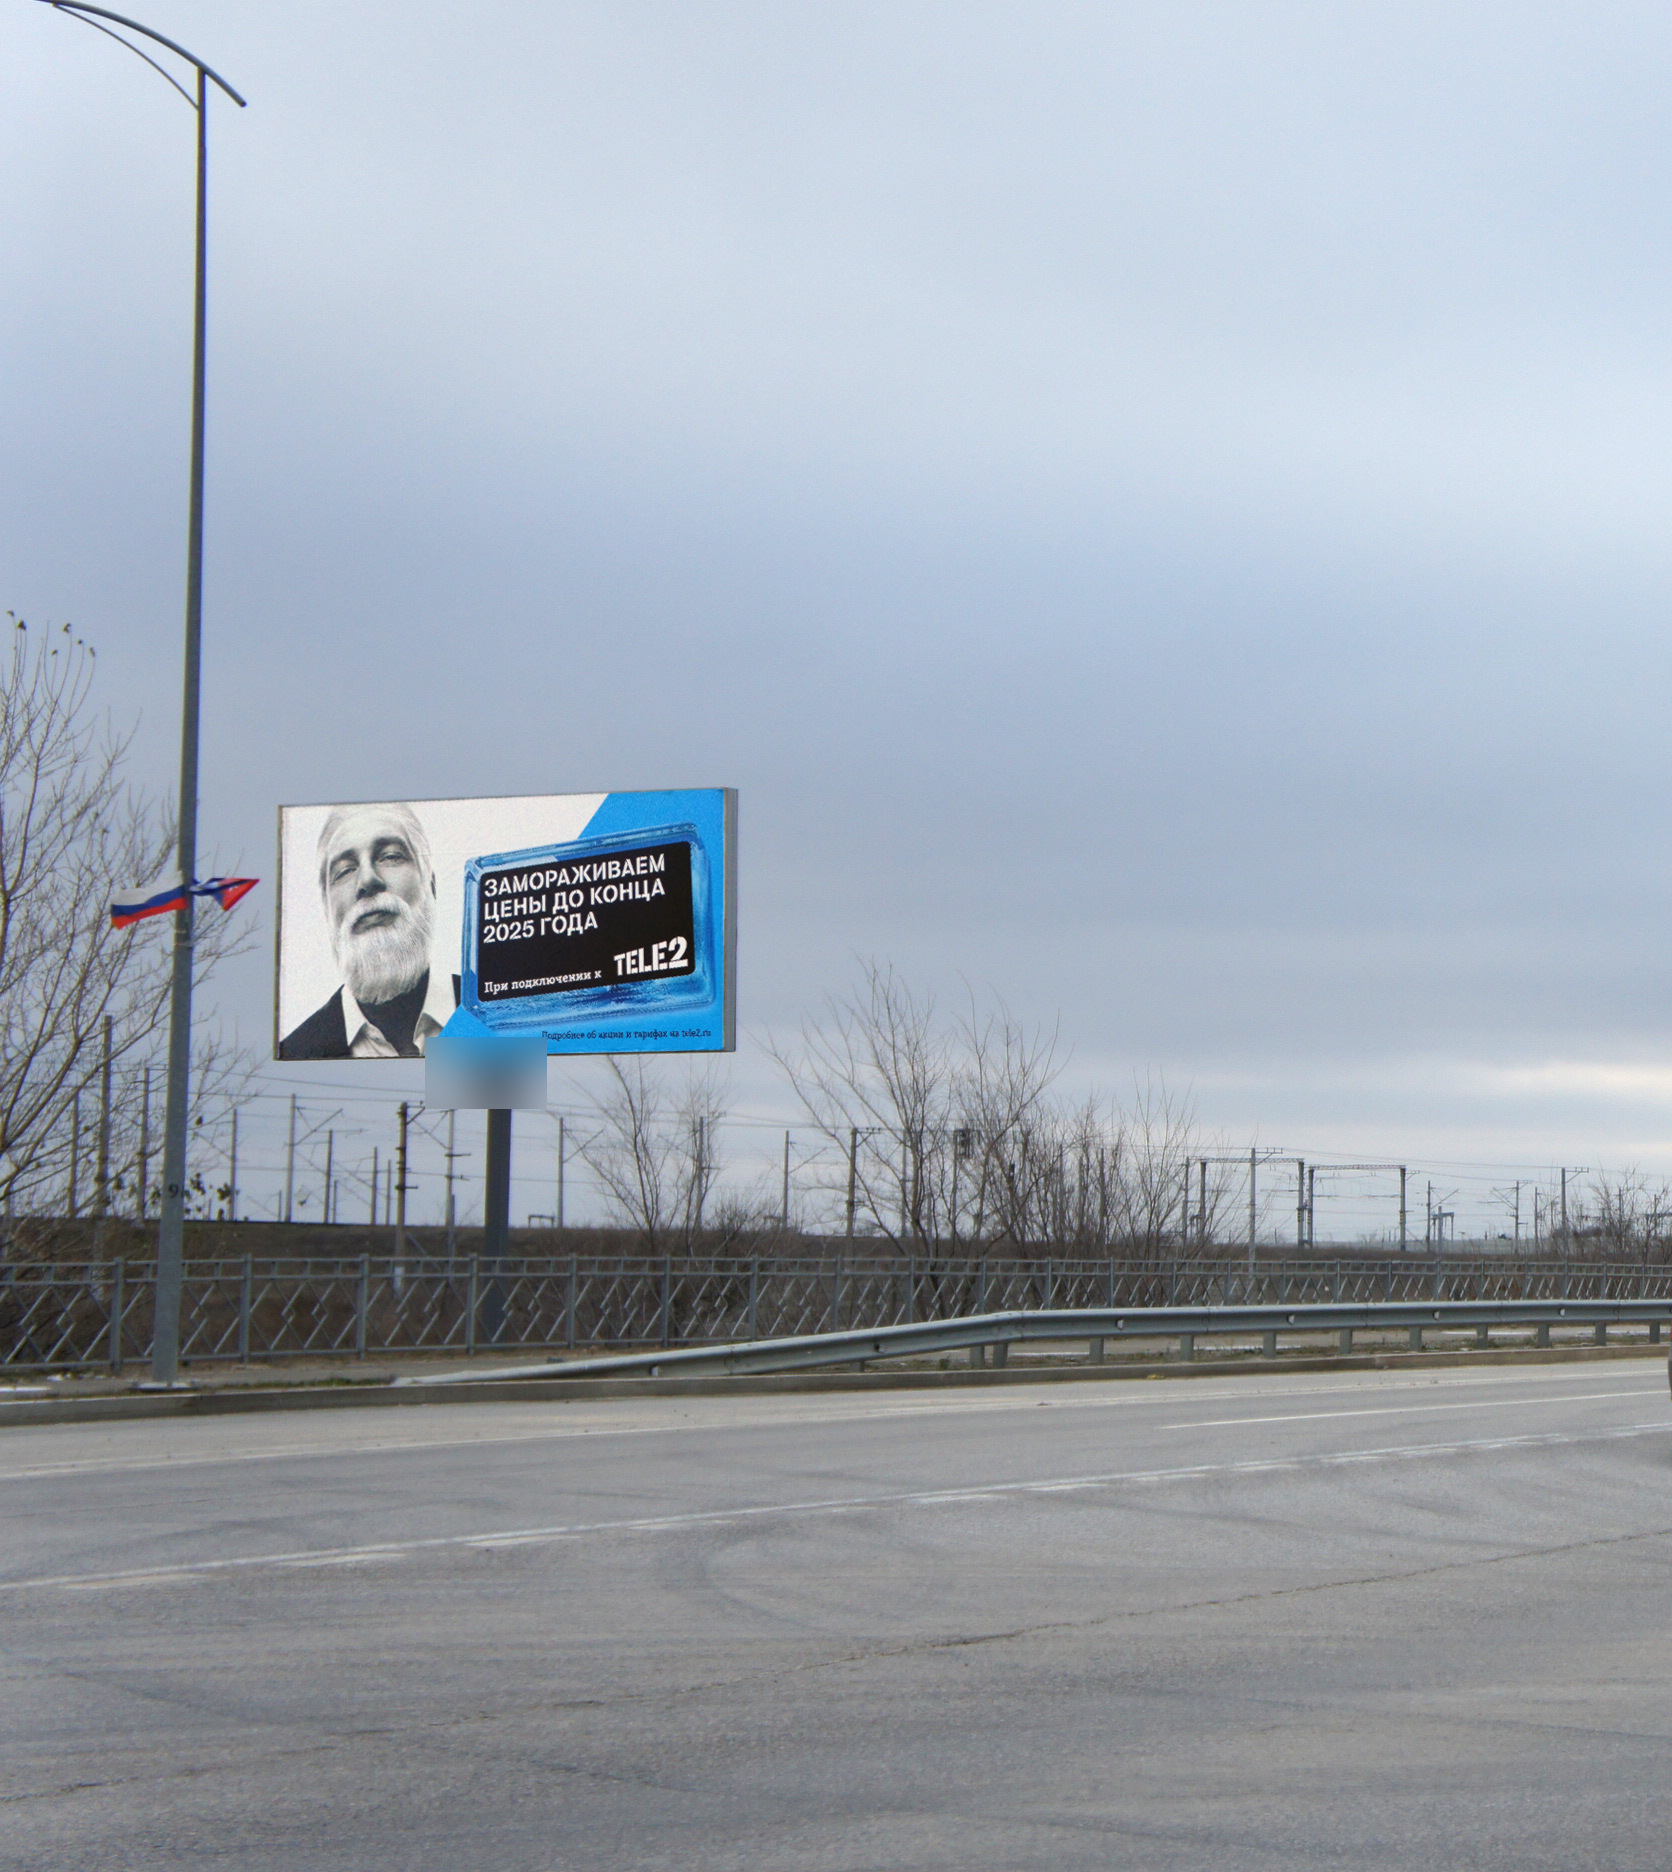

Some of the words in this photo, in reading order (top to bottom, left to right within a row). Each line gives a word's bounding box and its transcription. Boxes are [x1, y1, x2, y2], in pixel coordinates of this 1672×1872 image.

[484, 853, 666, 897] ЗАМОРАЖИВАЕМ
[484, 894, 546, 923] ЦЕНЫ
[552, 889, 584, 914] ДО
[590, 878, 666, 906] КОНЦА
[483, 919, 535, 944] 2025
[540, 911, 598, 937] ГОДА
[613, 936, 689, 976] TELE2
[484, 981, 509, 995] При
[511, 972, 592, 991] подключении
[594, 970, 602, 979] к
[586, 1029, 597, 1039] об
[598, 1031, 624, 1040] акции
[625, 1031, 632, 1039] и
[633, 1030, 668, 1041] тарифах
[669, 1030, 680, 1039] на
[681, 1028, 712, 1038] tele2.ru
